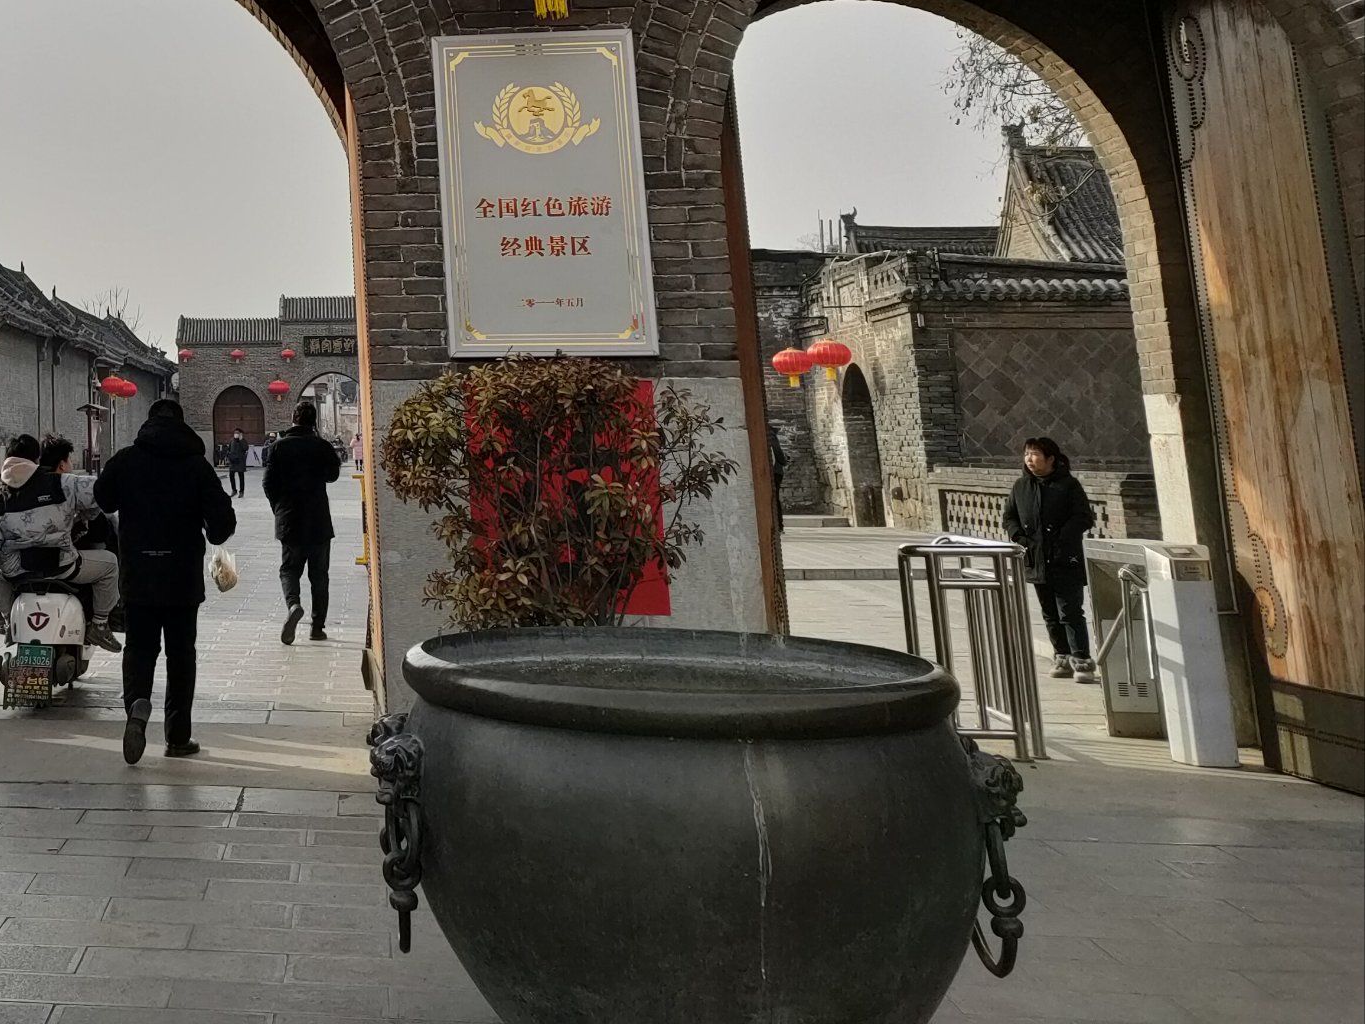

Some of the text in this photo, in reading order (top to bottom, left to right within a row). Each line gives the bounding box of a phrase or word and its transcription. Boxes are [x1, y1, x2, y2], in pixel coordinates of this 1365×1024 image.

[474, 195, 613, 219] 全国红色旅游
[499, 235, 593, 258] 经典景区
